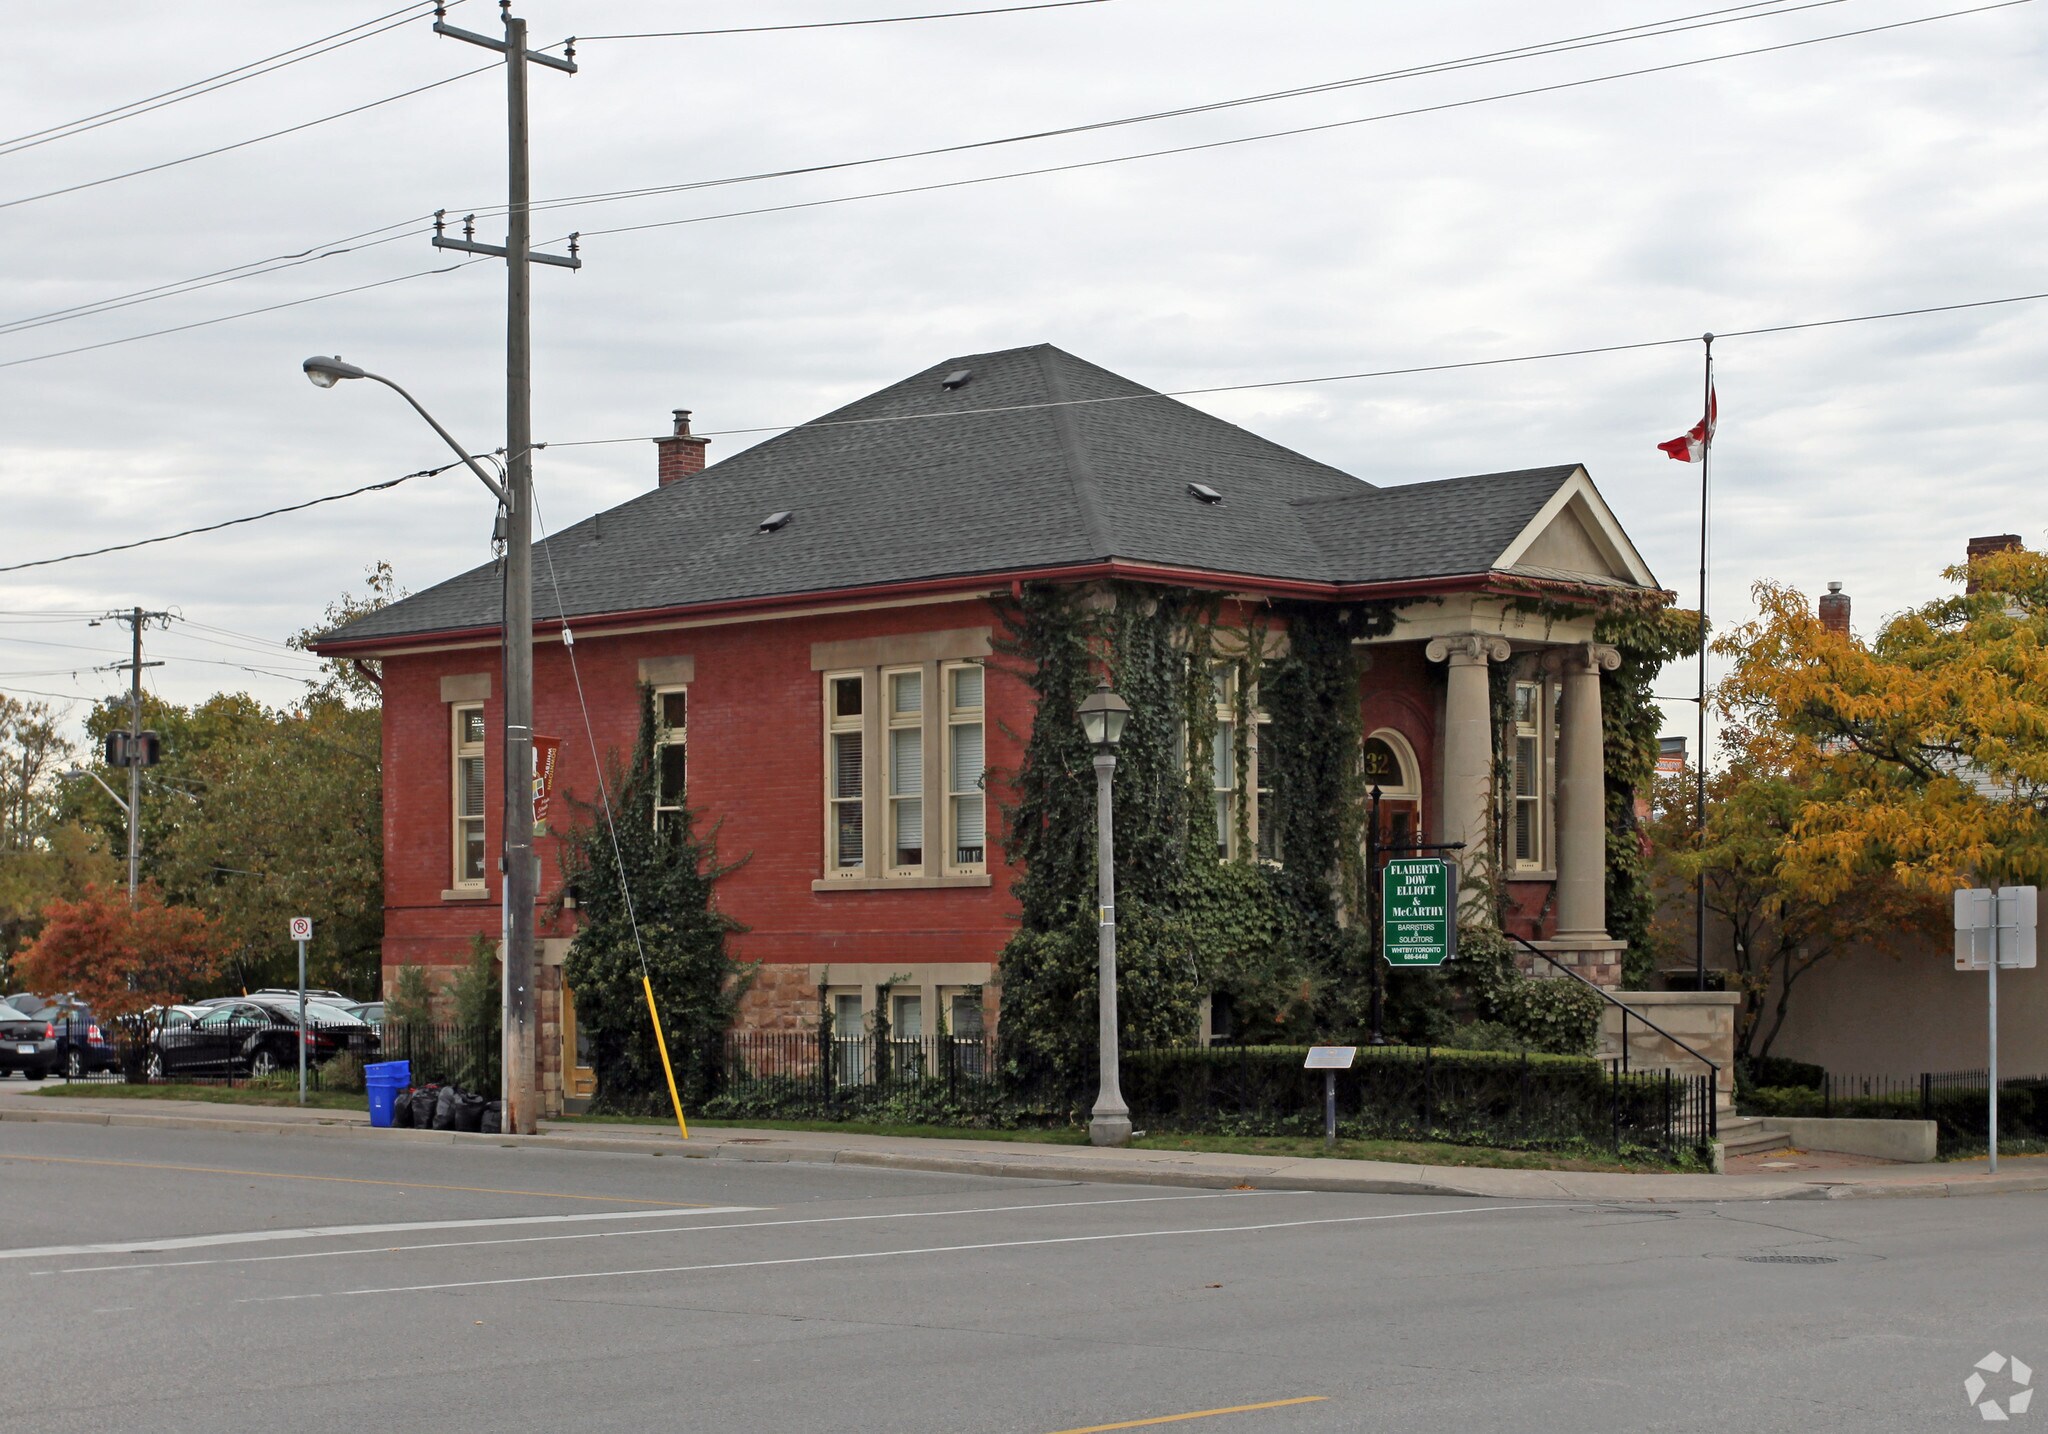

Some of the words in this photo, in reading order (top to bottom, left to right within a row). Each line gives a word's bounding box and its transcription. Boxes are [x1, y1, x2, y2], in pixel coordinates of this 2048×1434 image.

[547, 748, 557, 790] DOWNTOWN
[1391, 864, 1441, 875] FLAHERTY
[1405, 875, 1427, 885] DOW
[1396, 886, 1437, 896] ELLIOTT
[1412, 896, 1421, 906] &
[1392, 906, 1444, 917] McCARTHY
[1397, 923, 1435, 931] BARRISTERS
[1391, 946, 1441, 954] WHITBY/TORONTO
